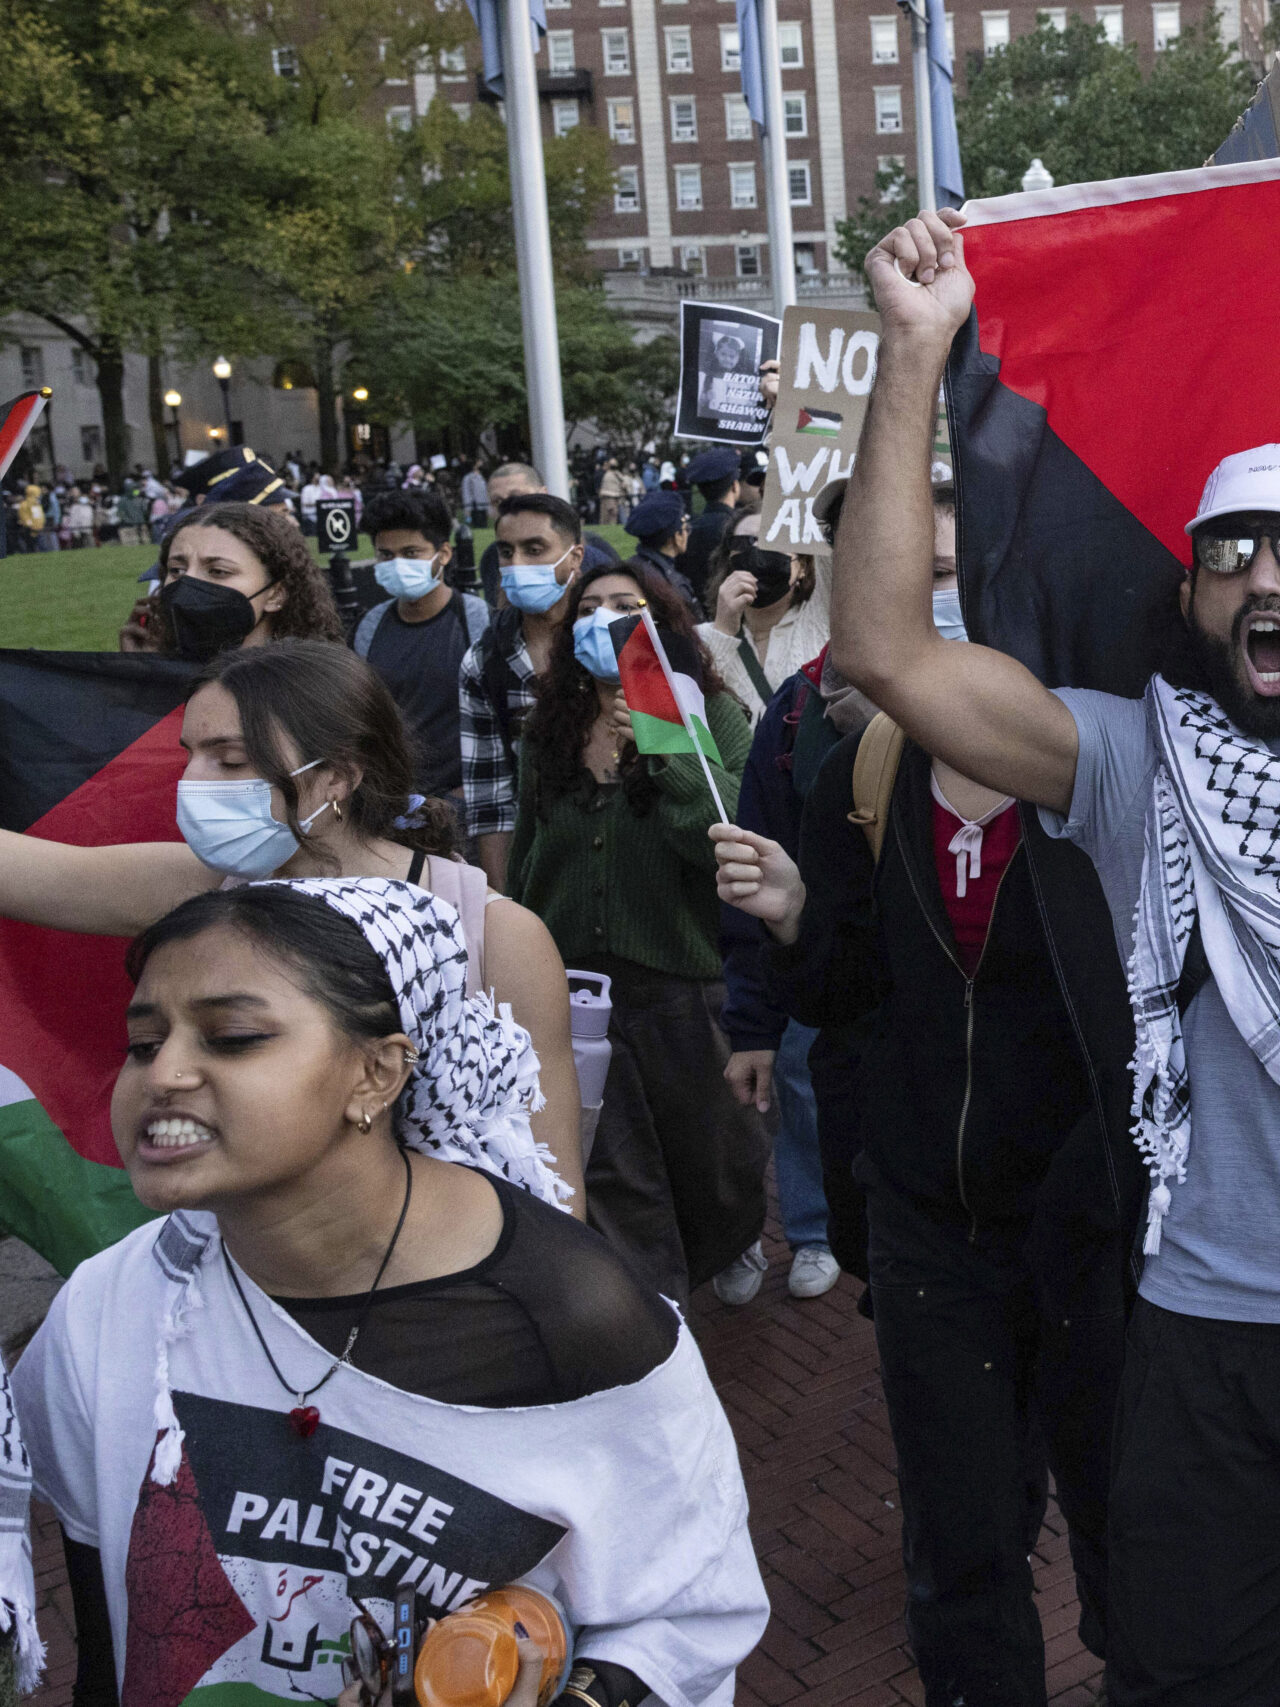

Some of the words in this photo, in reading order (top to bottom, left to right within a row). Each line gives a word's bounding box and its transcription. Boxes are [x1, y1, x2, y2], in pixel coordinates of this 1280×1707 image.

[793, 322, 879, 396] NO
[718, 420, 765, 432] SHABAN
[320, 1456, 455, 1545] FREE
